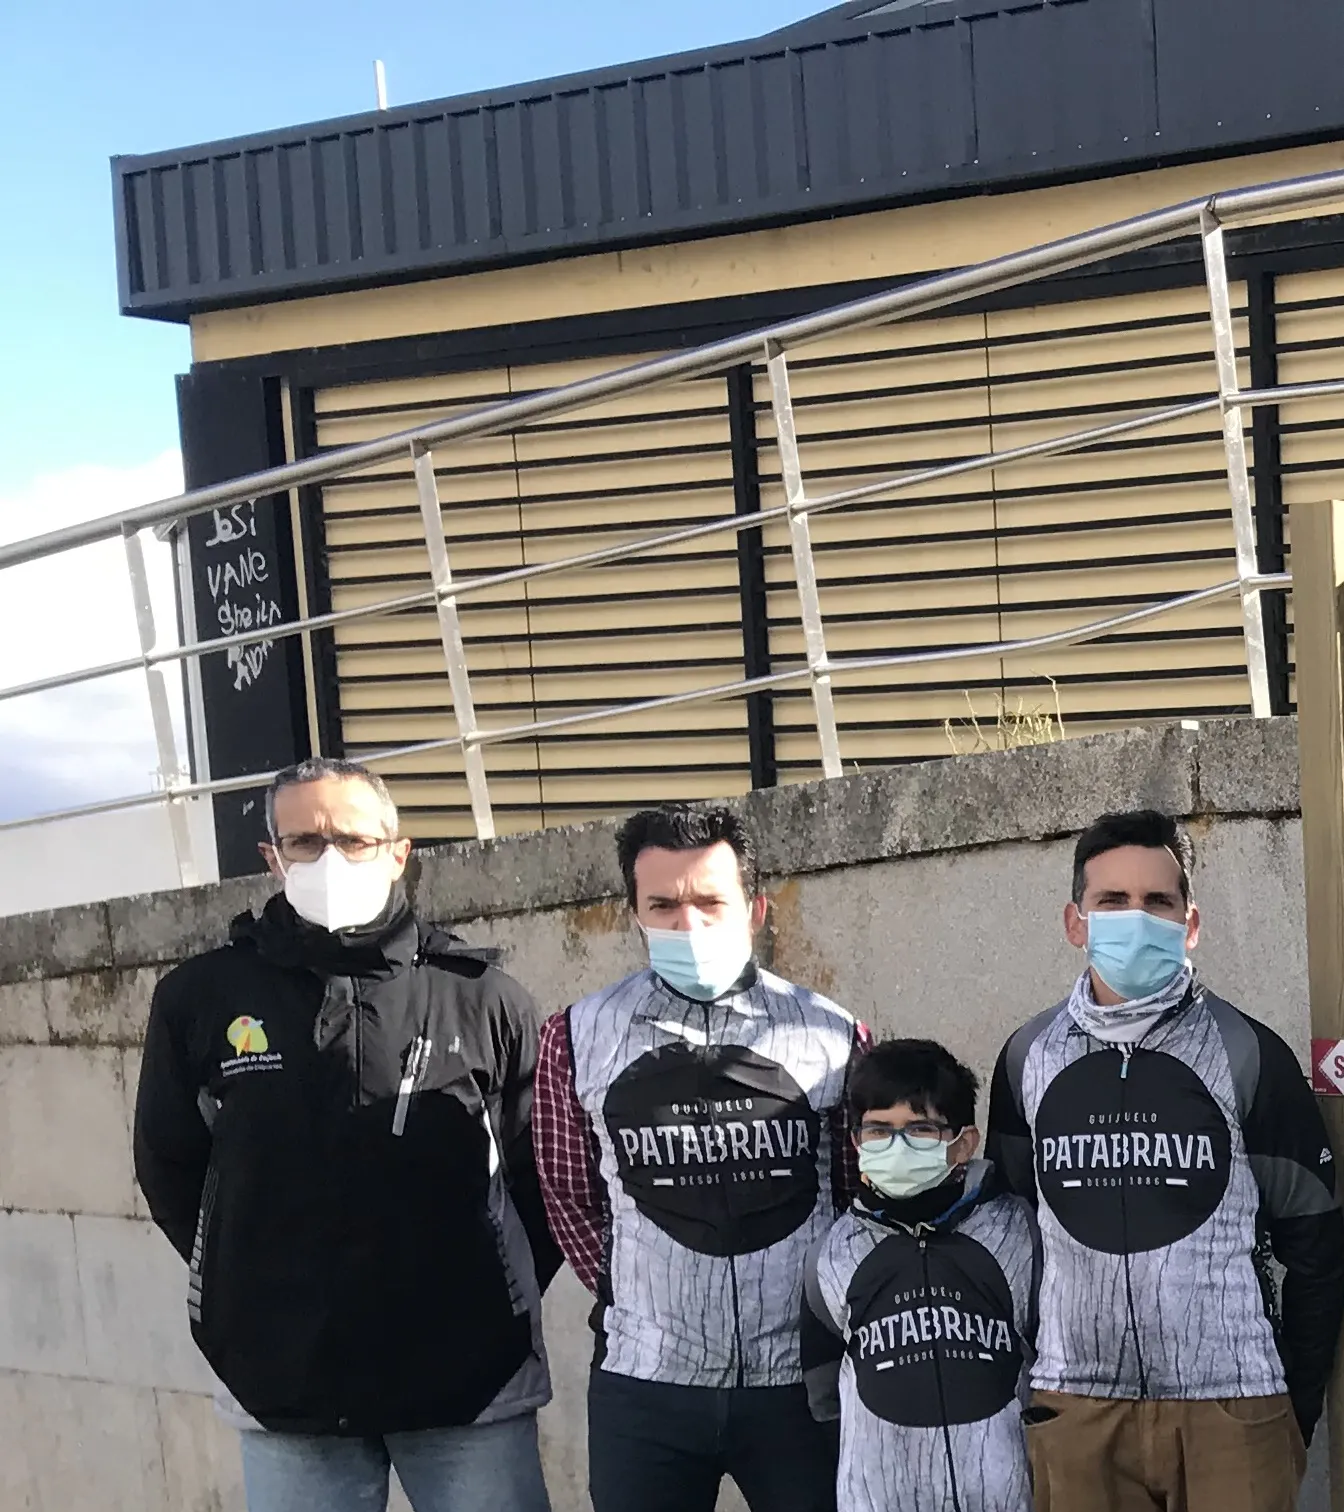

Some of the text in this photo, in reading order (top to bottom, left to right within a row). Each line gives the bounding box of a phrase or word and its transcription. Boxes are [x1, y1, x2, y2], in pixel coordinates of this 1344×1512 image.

[1089, 1111, 1158, 1125] GUIJUELO
[618, 1119, 811, 1167] PATABRAVA
[1042, 1132, 1216, 1172] PATABRAVA
